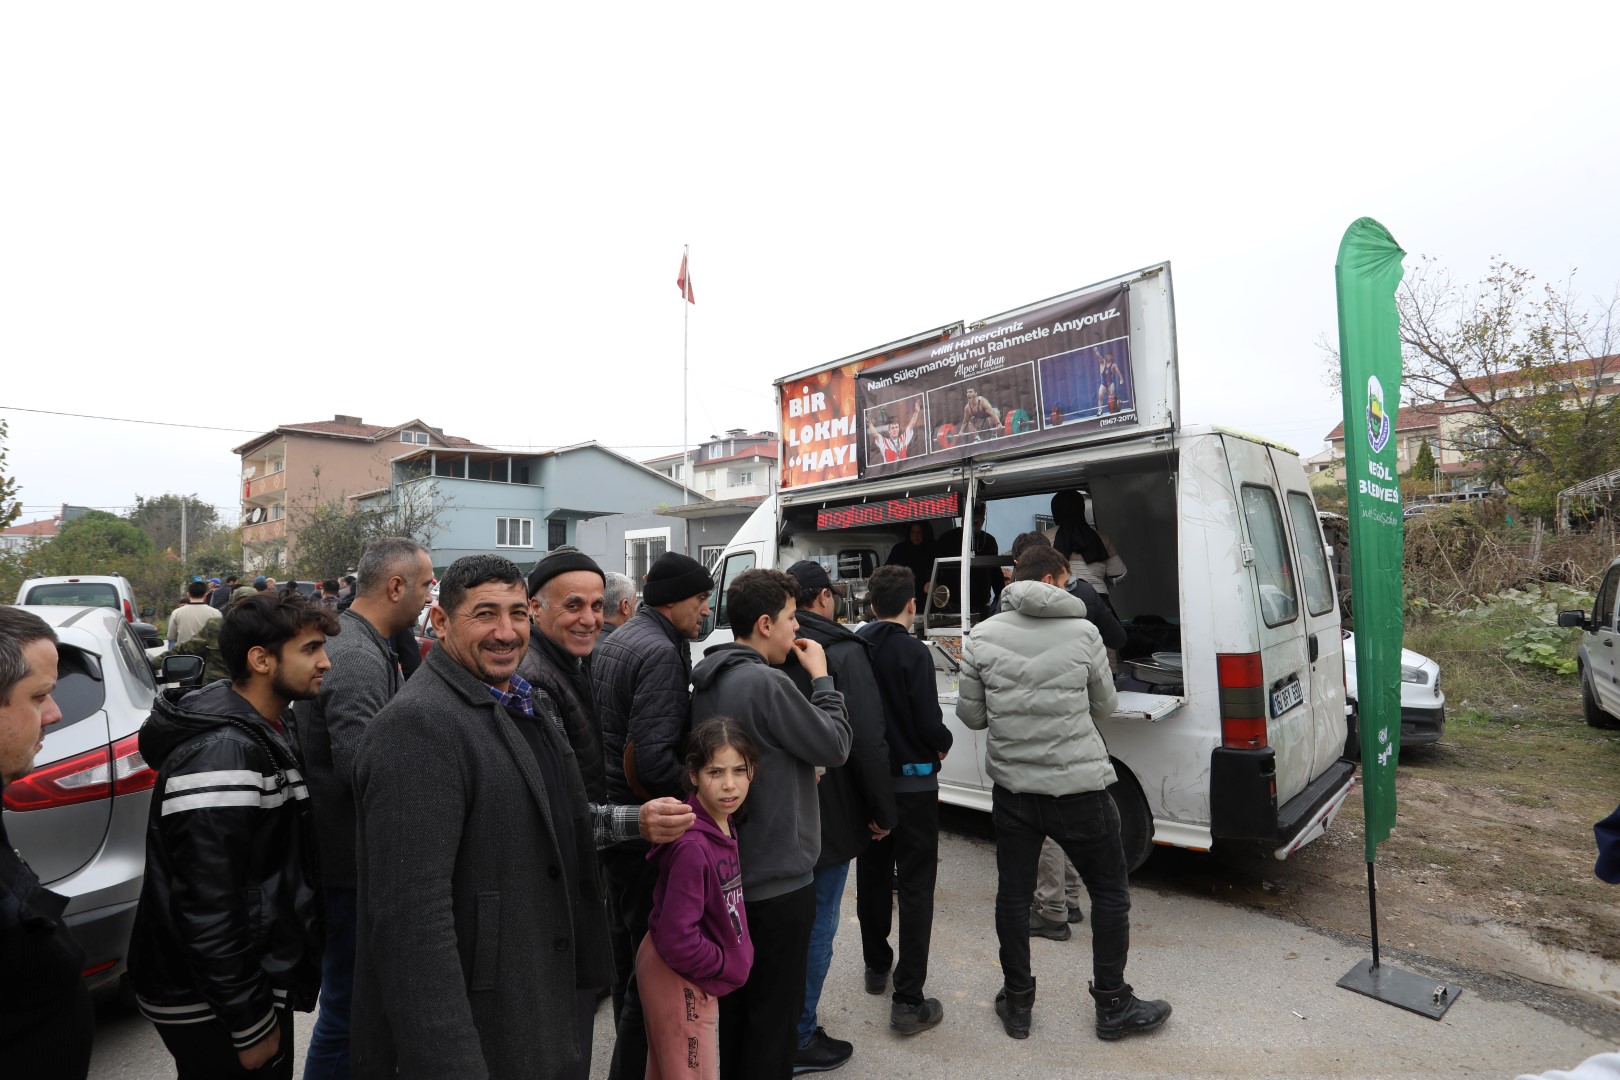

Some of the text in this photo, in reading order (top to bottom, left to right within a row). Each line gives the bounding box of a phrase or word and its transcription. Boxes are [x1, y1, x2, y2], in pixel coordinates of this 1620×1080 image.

[867, 375, 893, 391] Naim
[894, 348, 986, 383] Süleymanoğlu'nu
[987, 327, 1050, 353] Rahmetle
[1053, 307, 1121, 335] Anıyoruz.
[931, 342, 954, 358] Milli
[954, 362, 978, 378] Alper
[978, 355, 1006, 370] Taban
[789, 385, 826, 418] BİR
